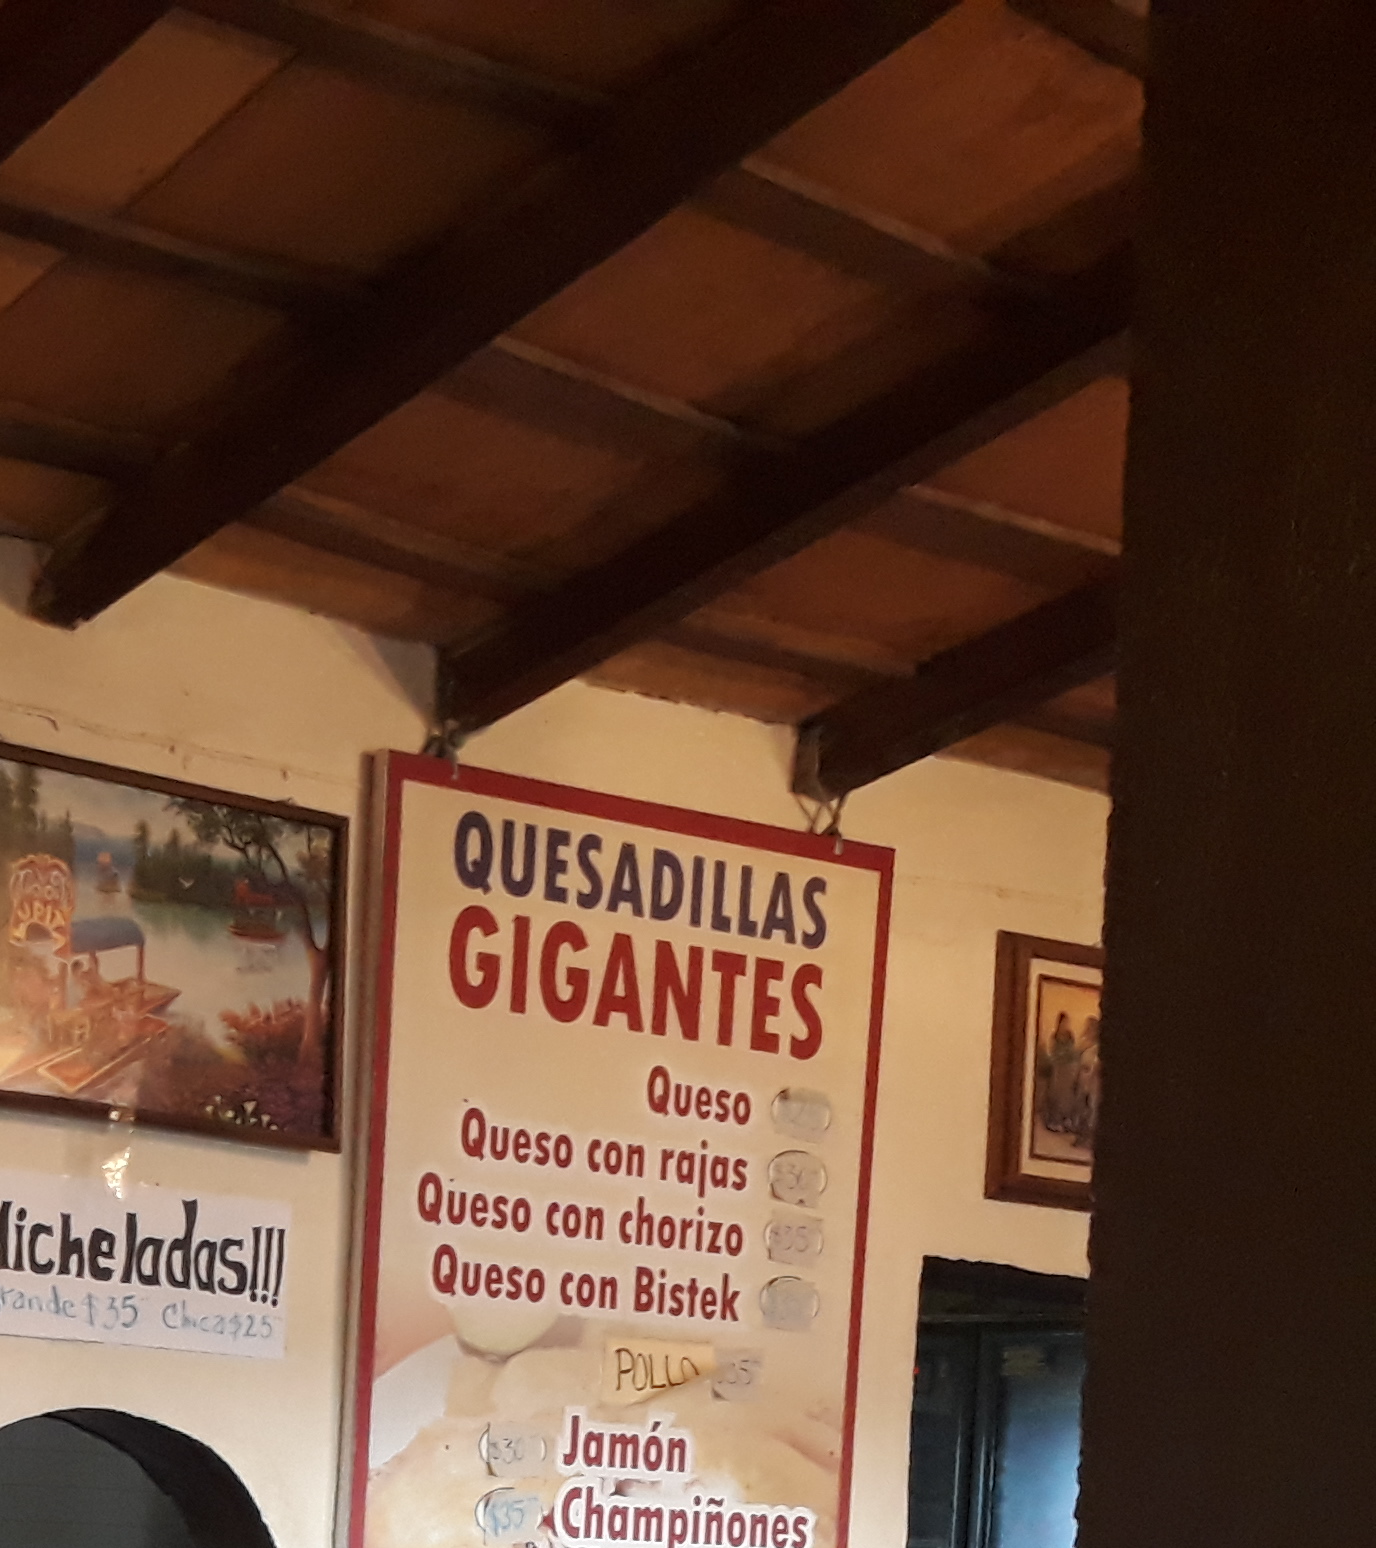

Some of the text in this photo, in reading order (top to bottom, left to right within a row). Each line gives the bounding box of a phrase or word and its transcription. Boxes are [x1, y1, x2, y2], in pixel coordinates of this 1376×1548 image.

[453, 810, 828, 950] QUESADILLAS
[448, 905, 824, 1062] GIGANTES
[647, 1065, 751, 1127] Queso
[460, 1107, 749, 1199] Queso con rajas
[417, 1172, 745, 1258] Queso con chorizo
[431, 1245, 546, 1303] Queso
[559, 1268, 618, 1310] con
[634, 1266, 741, 1323] Bistek
[561, 1415, 688, 1474] Jamón
